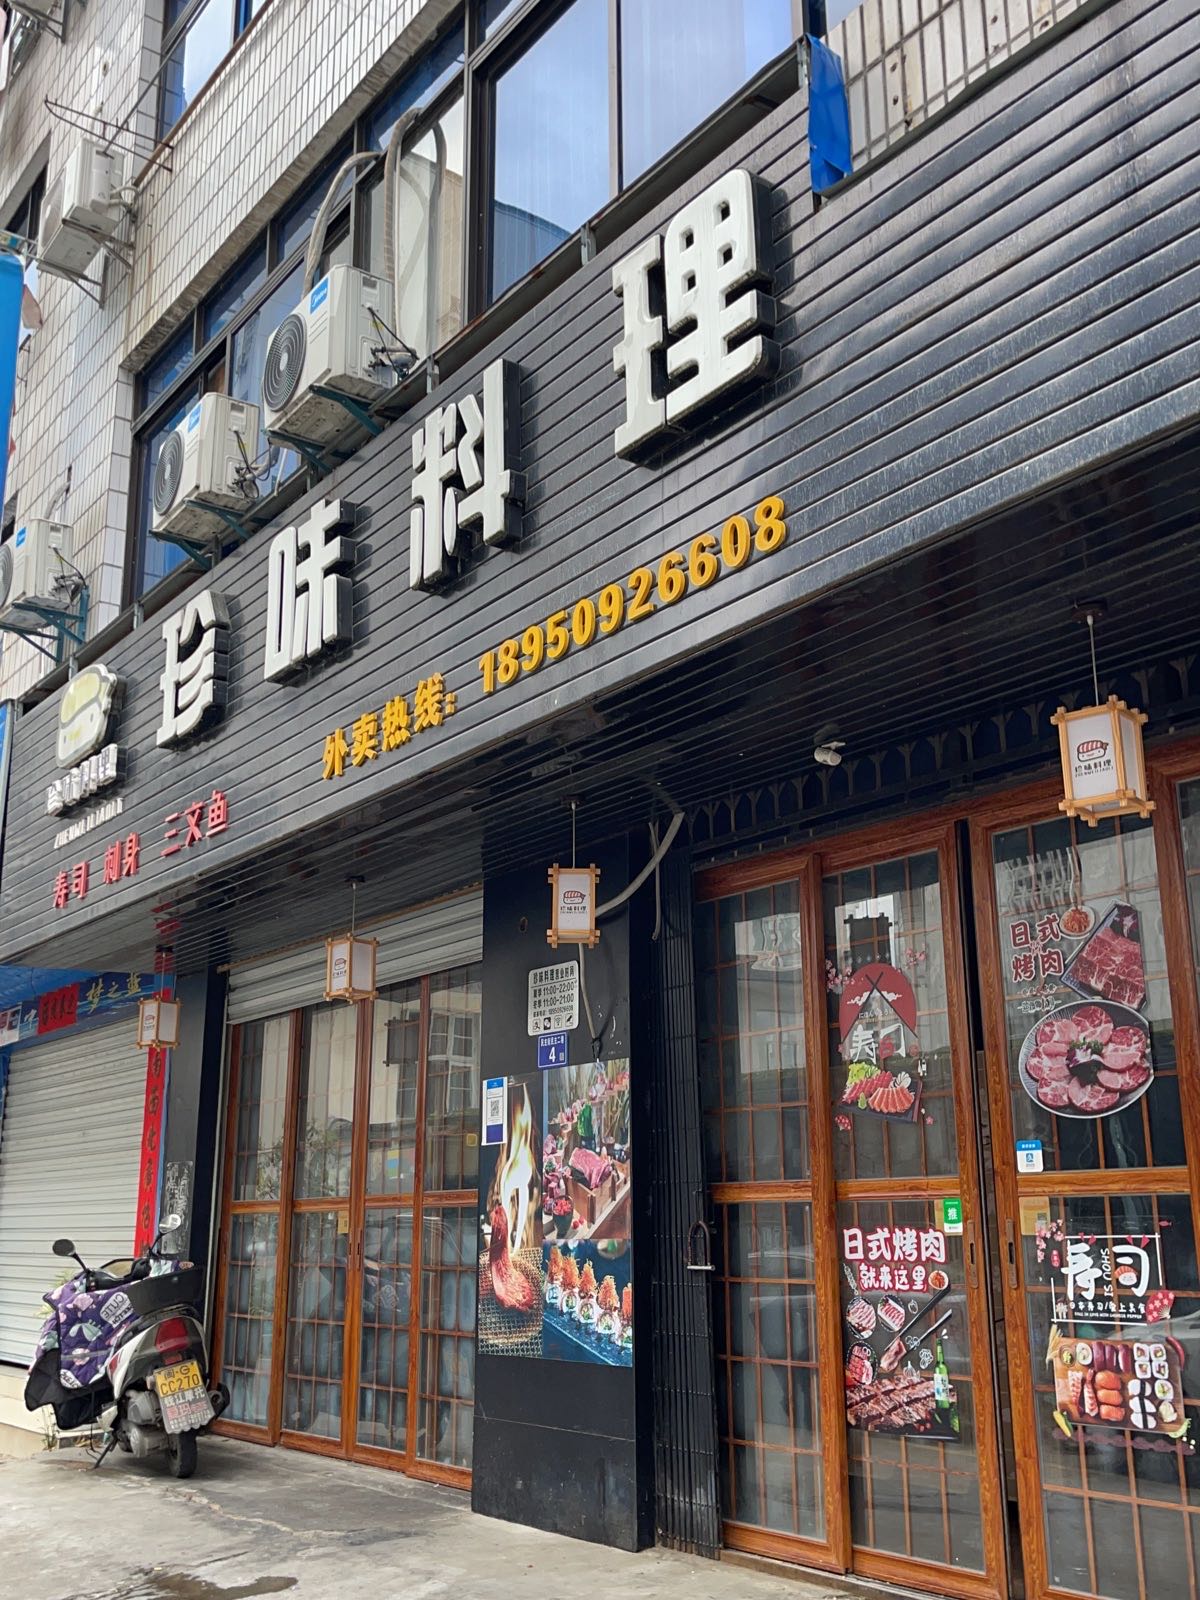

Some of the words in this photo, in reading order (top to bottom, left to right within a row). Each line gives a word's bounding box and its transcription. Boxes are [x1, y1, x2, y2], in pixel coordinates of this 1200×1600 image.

[156, 168, 764, 748] 珍味料理
[479, 496, 786, 693] 18950926608
[53, 861, 89, 908] 寿司
[104, 832, 140, 884] 刺身
[160, 789, 228, 857] 三文鱼
[1010, 913, 1061, 949] 日式
[1011, 948, 1064, 983] 烤肉
[549, 1046, 556, 1063] 4
[843, 1227, 945, 1263] 日式烤肉
[859, 1262, 926, 1290] 就来这里
[1061, 1239, 1150, 1300] 寿司
[160, 1373, 200, 1395] CC270
